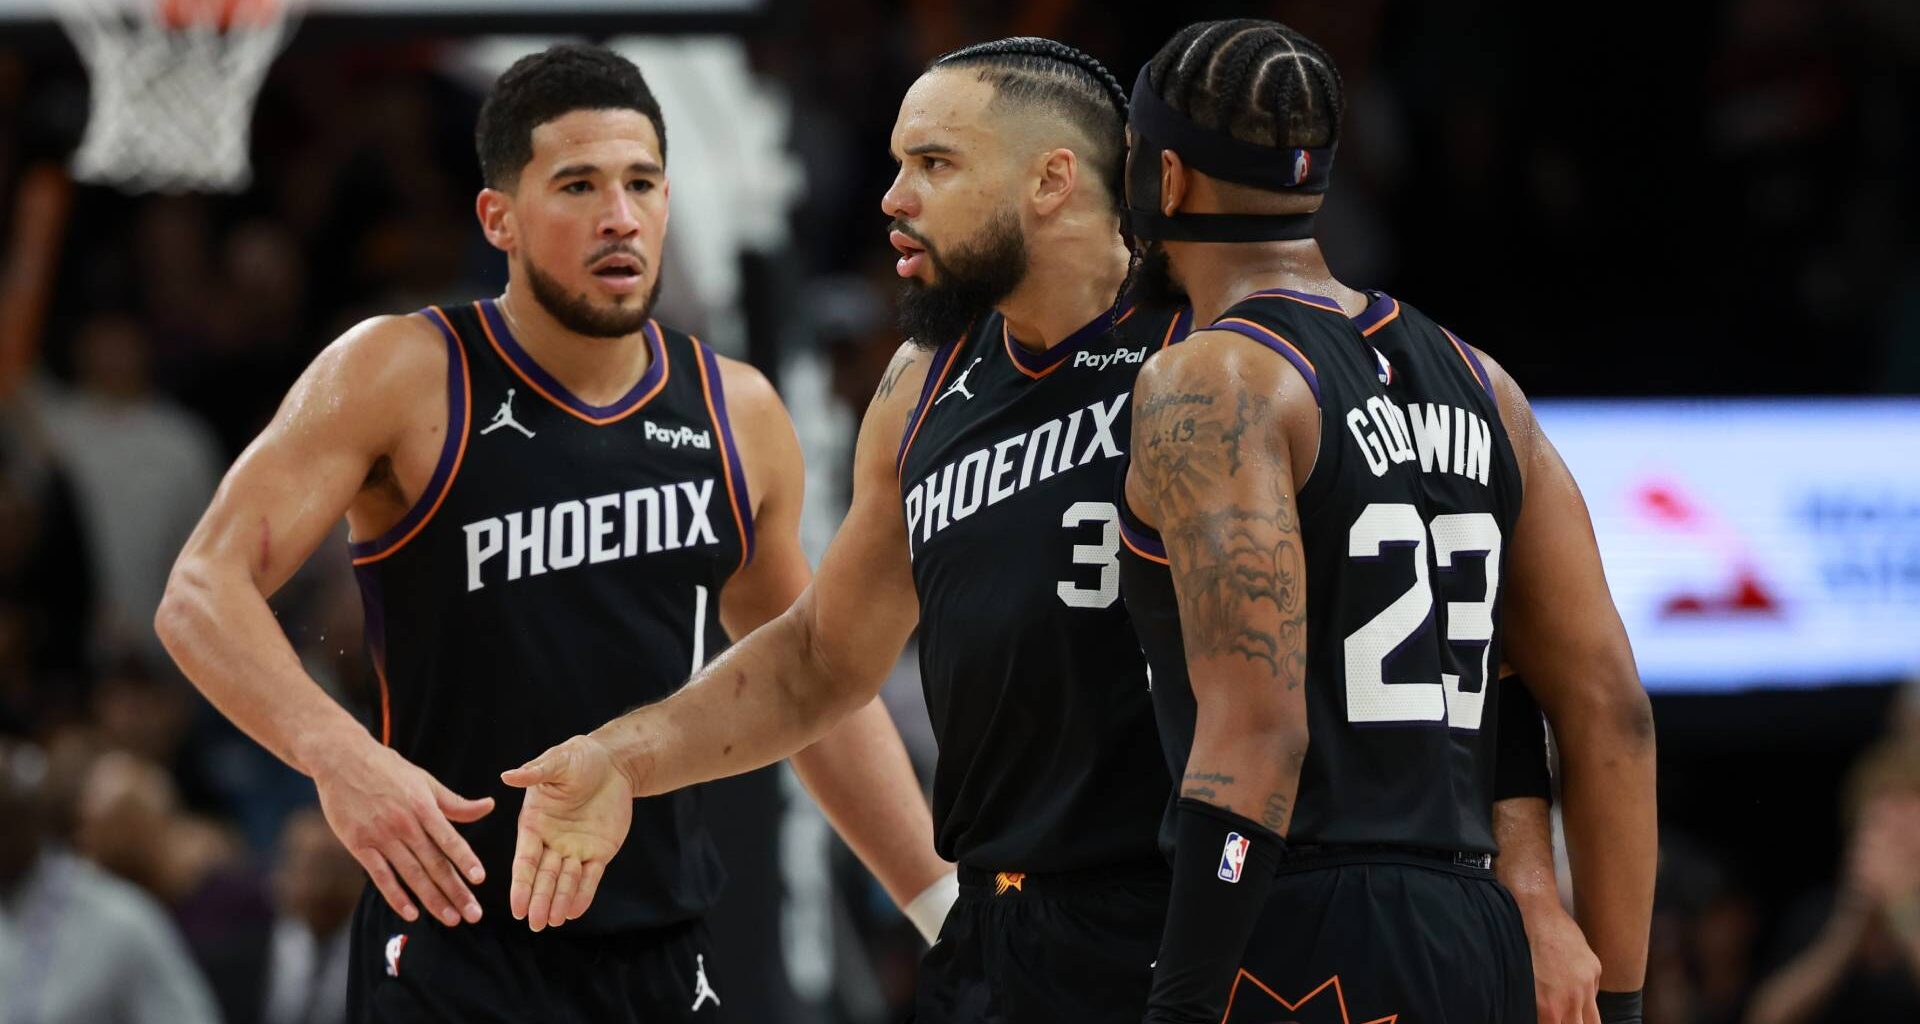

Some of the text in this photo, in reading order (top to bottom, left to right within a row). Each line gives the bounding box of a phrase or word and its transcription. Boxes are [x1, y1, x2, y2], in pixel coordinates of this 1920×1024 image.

[1073, 346, 1148, 371] PayPal
[644, 420, 711, 450] PayPal
[905, 391, 1130, 563] PHOENIX
[462, 478, 720, 592] PHOENIX
[1056, 501, 1121, 609] 3
[1344, 503, 1502, 729] 23
